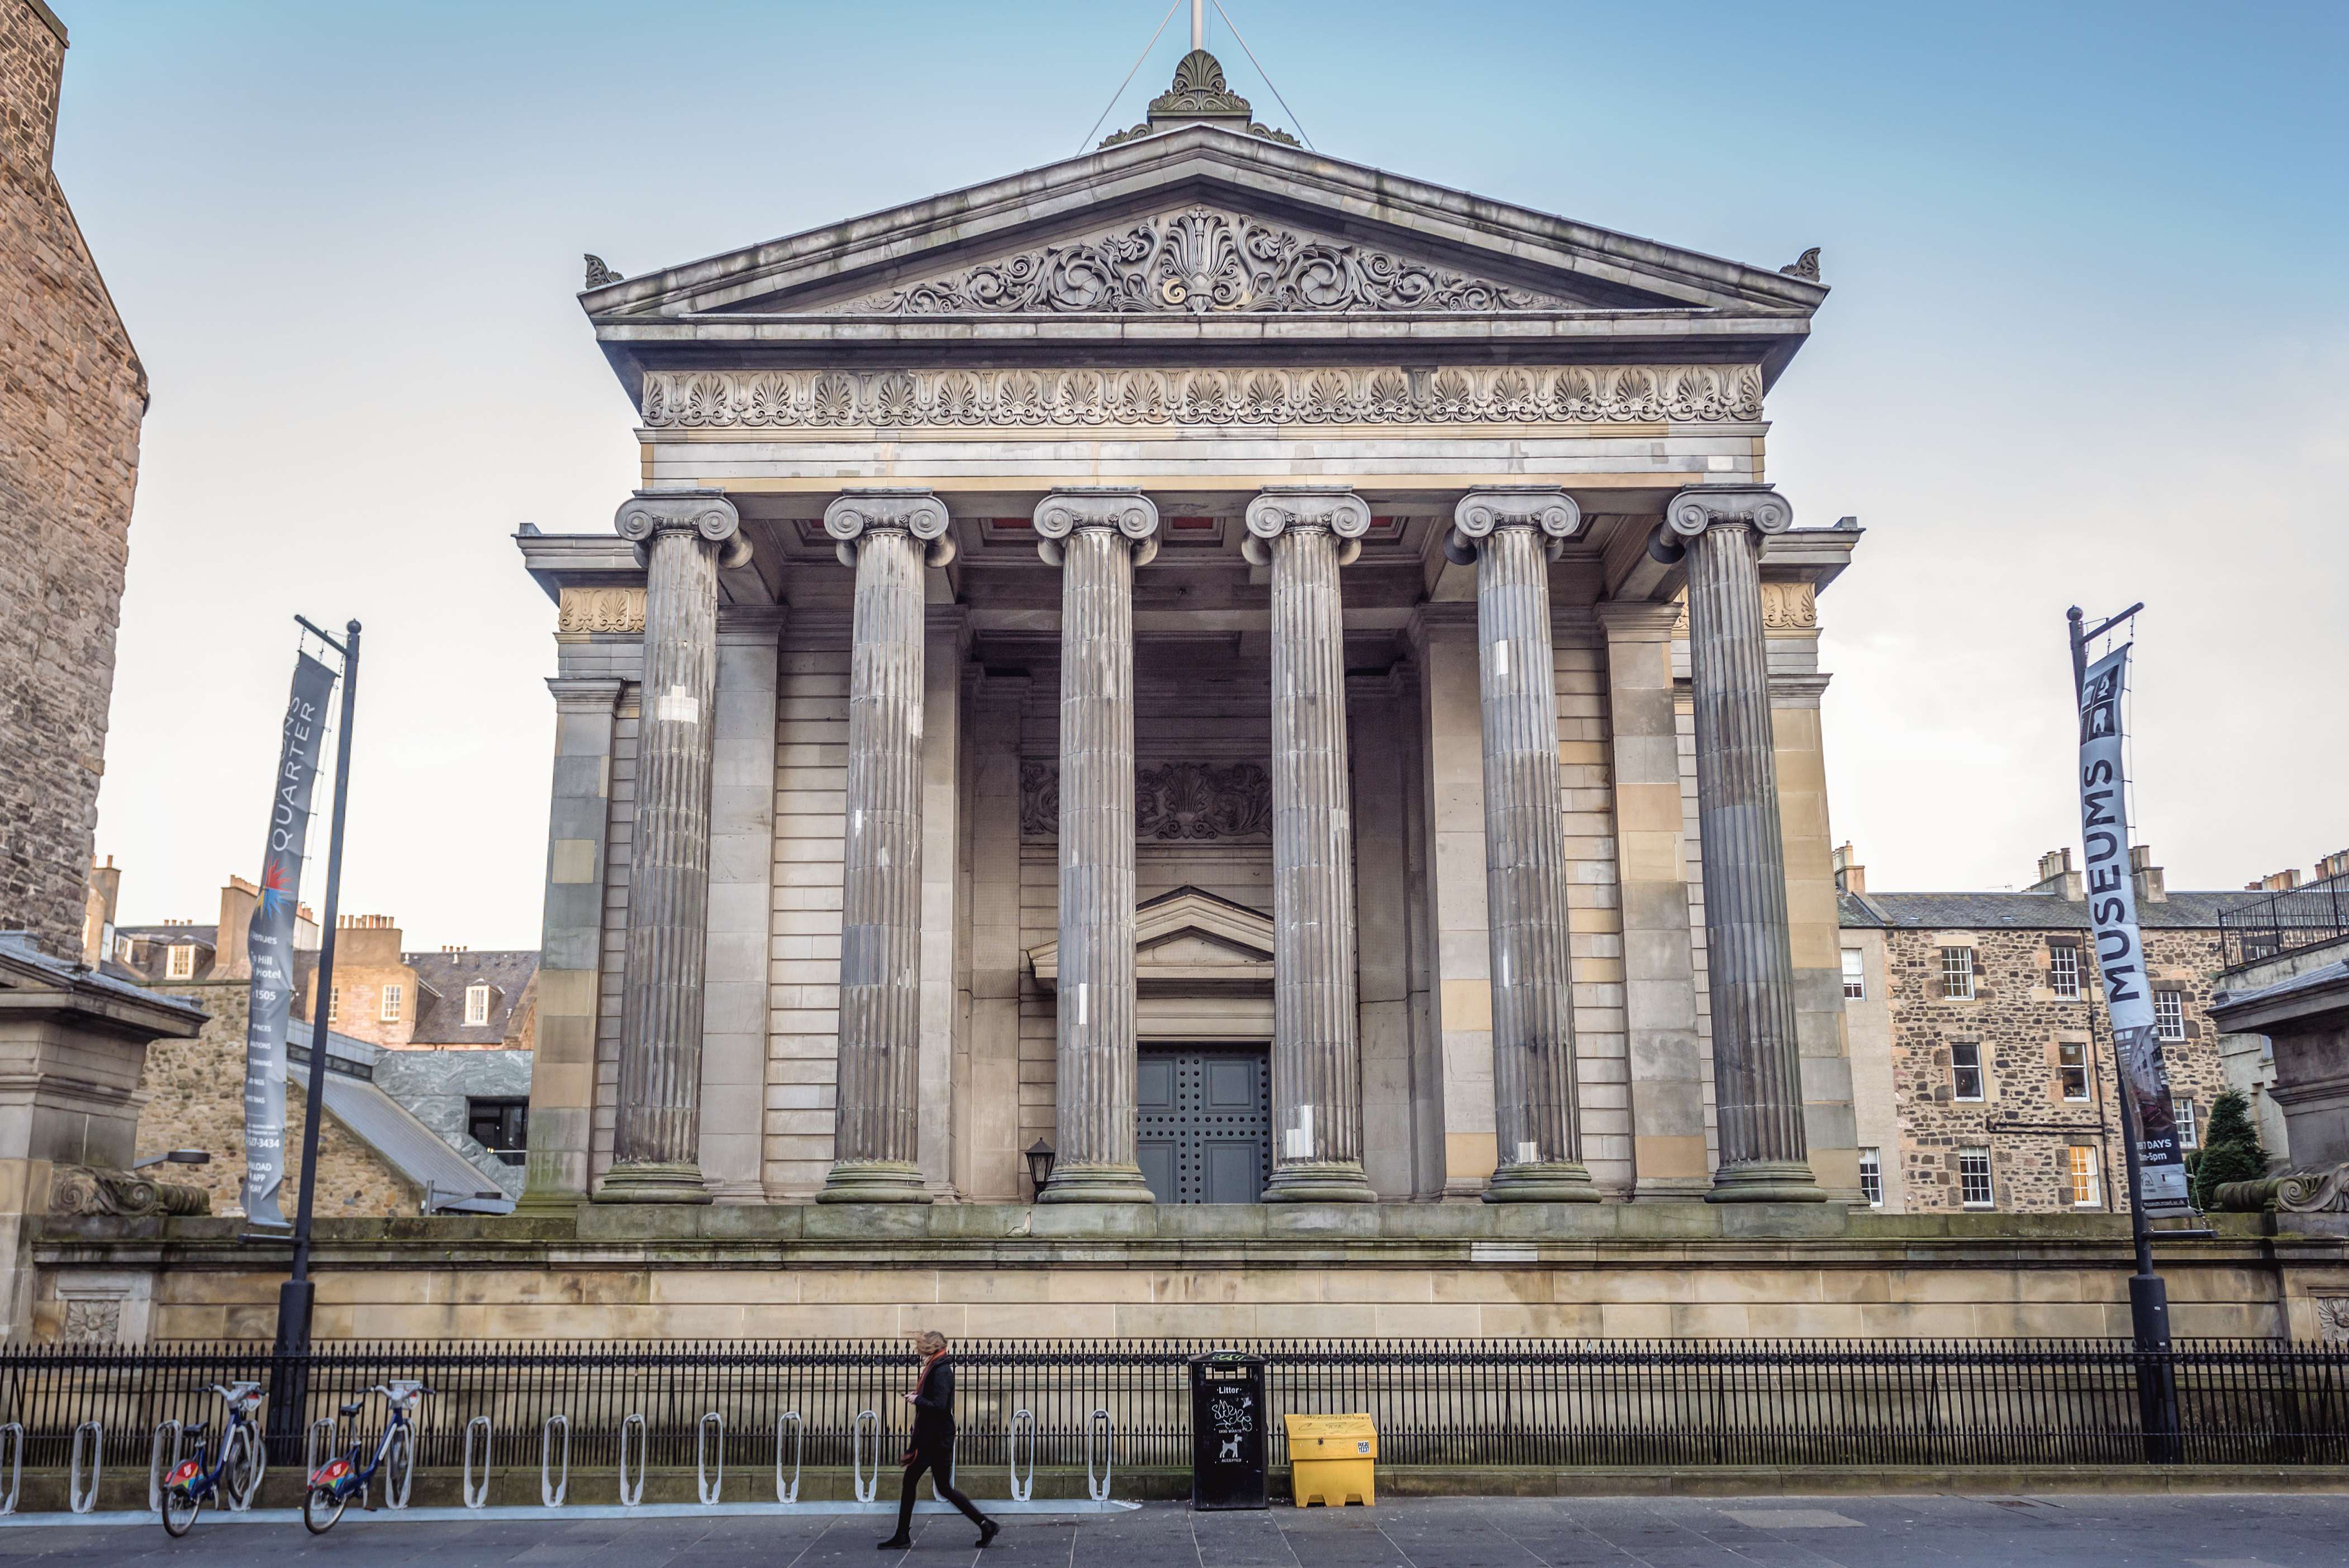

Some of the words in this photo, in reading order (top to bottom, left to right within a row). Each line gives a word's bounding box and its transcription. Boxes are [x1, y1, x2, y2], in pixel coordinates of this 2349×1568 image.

[273, 702, 316, 851] QUARTER
[2084, 759, 2140, 1004] MUSEUMS
[258, 955, 273, 966] Hill
[255, 989, 277, 1001] 1505
[2147, 1139, 2172, 1149] DAYS
